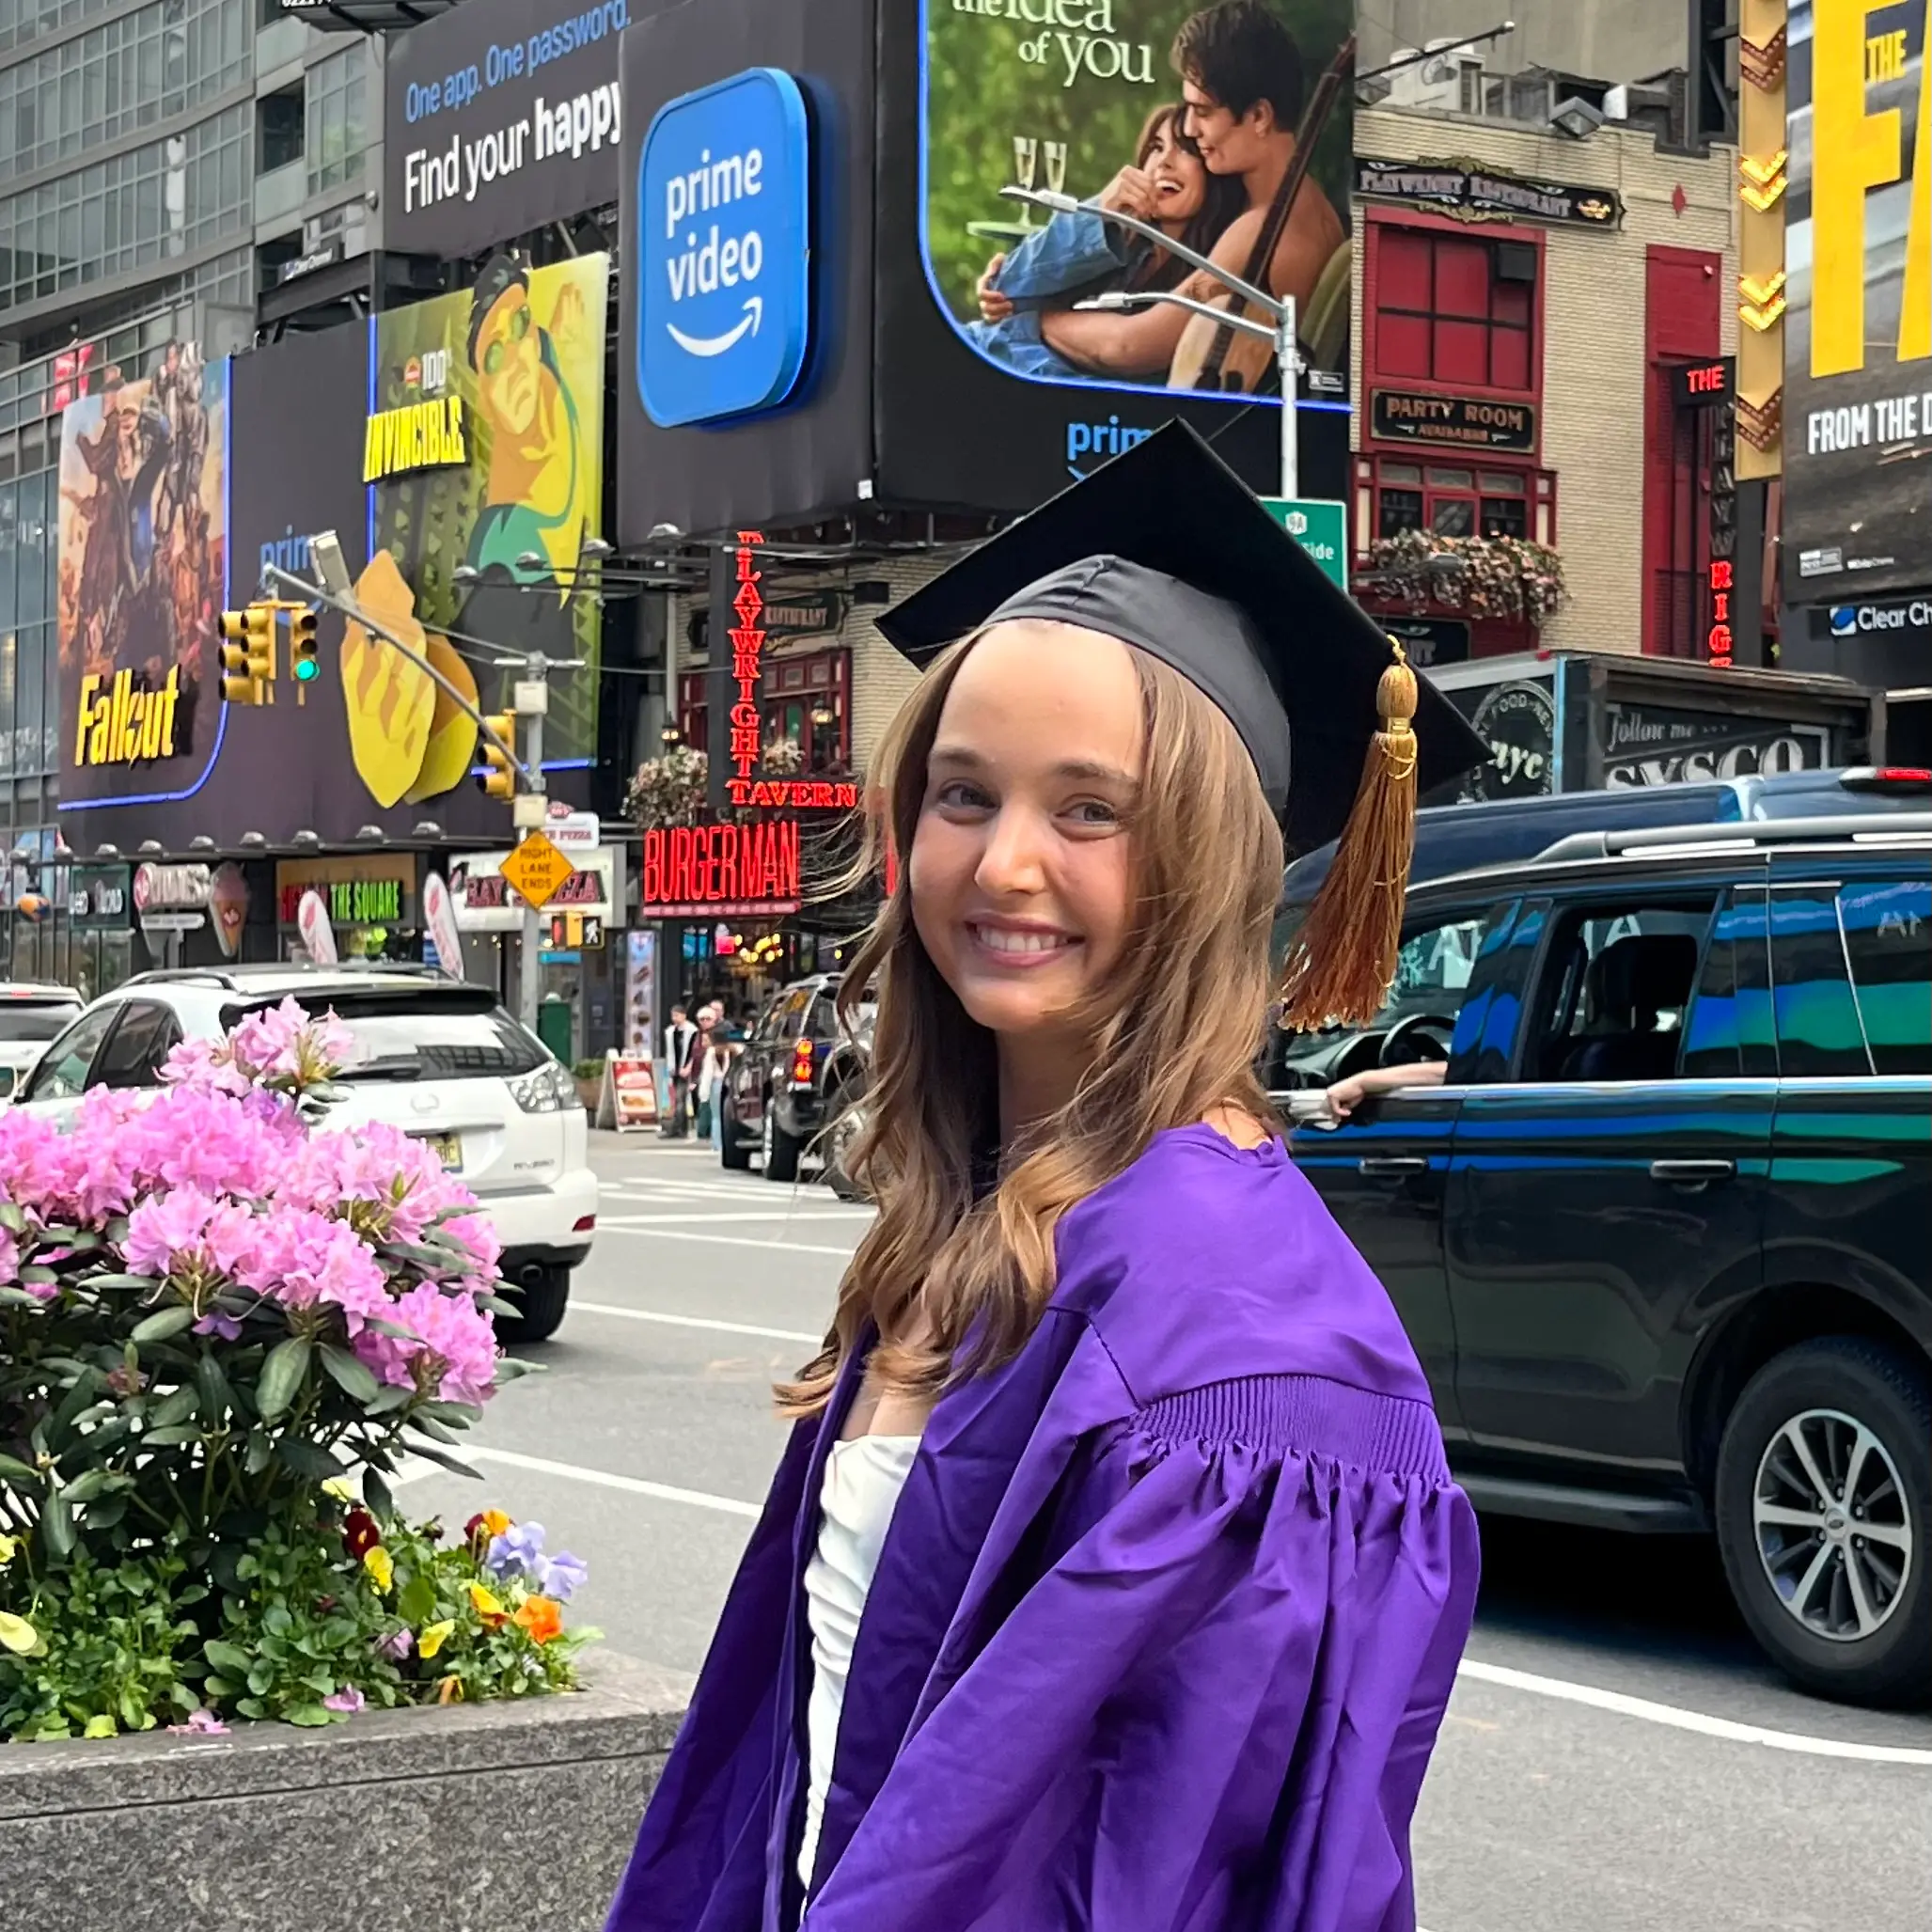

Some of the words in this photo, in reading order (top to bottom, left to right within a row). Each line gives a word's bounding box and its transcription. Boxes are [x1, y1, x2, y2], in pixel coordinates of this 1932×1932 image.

[406, 82, 441, 123] One
[444, 64, 482, 110] app.
[485, 44, 524, 86] One
[527, 0, 631, 77] password.
[1018, 31, 1051, 64] of
[1055, 32, 1155, 87] you
[1866, 29, 1907, 83] THE
[405, 134, 460, 213] Find
[464, 118, 530, 201] your
[667, 148, 762, 240] prime
[668, 225, 762, 302] video
[1686, 365, 1724, 393] THE
[363, 394, 466, 482] INVINCIBLE
[1387, 397, 1455, 419] PARTY
[1465, 404, 1523, 432] ROOM
[1808, 404, 1869, 455] FROM
[1874, 395, 1918, 443] THE
[1858, 605, 1907, 630] Clear
[75, 663, 179, 770] Fallout
[725, 778, 858, 808] TAVERN
[519, 848, 553, 860] RIGHT
[520, 863, 552, 874] LANE
[331, 883, 352, 921] THE
[353, 880, 400, 925] SQUARE
[521, 877, 553, 889] ENDS
